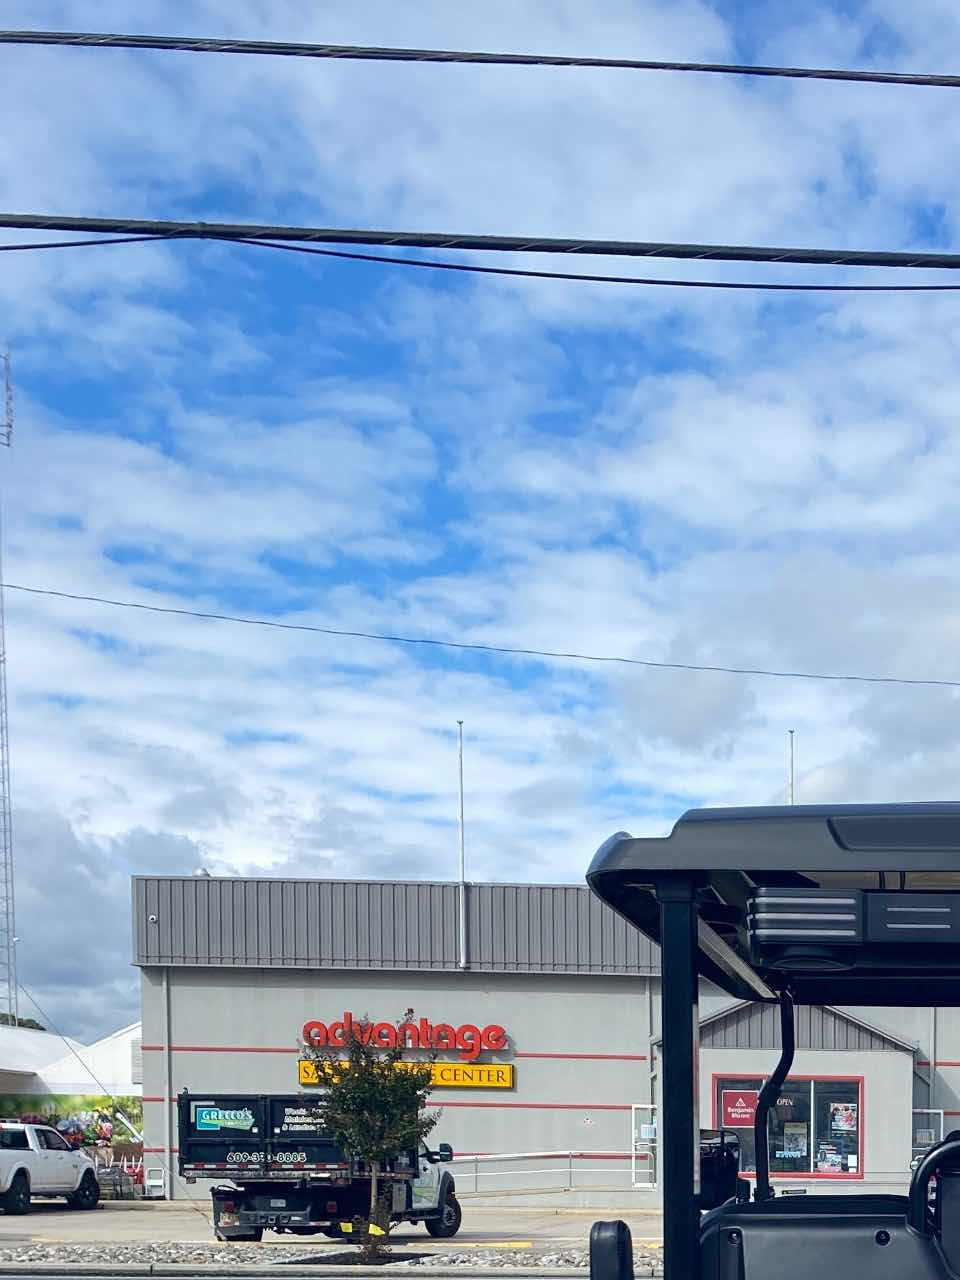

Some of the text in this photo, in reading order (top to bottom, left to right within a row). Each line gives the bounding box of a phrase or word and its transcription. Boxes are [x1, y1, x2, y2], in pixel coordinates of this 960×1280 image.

[303, 1012, 506, 1060] advantage
[440, 1068, 507, 1083] CENTER
[776, 1098, 793, 1106] OPEN
[727, 1106, 754, 1114] Benjamin
